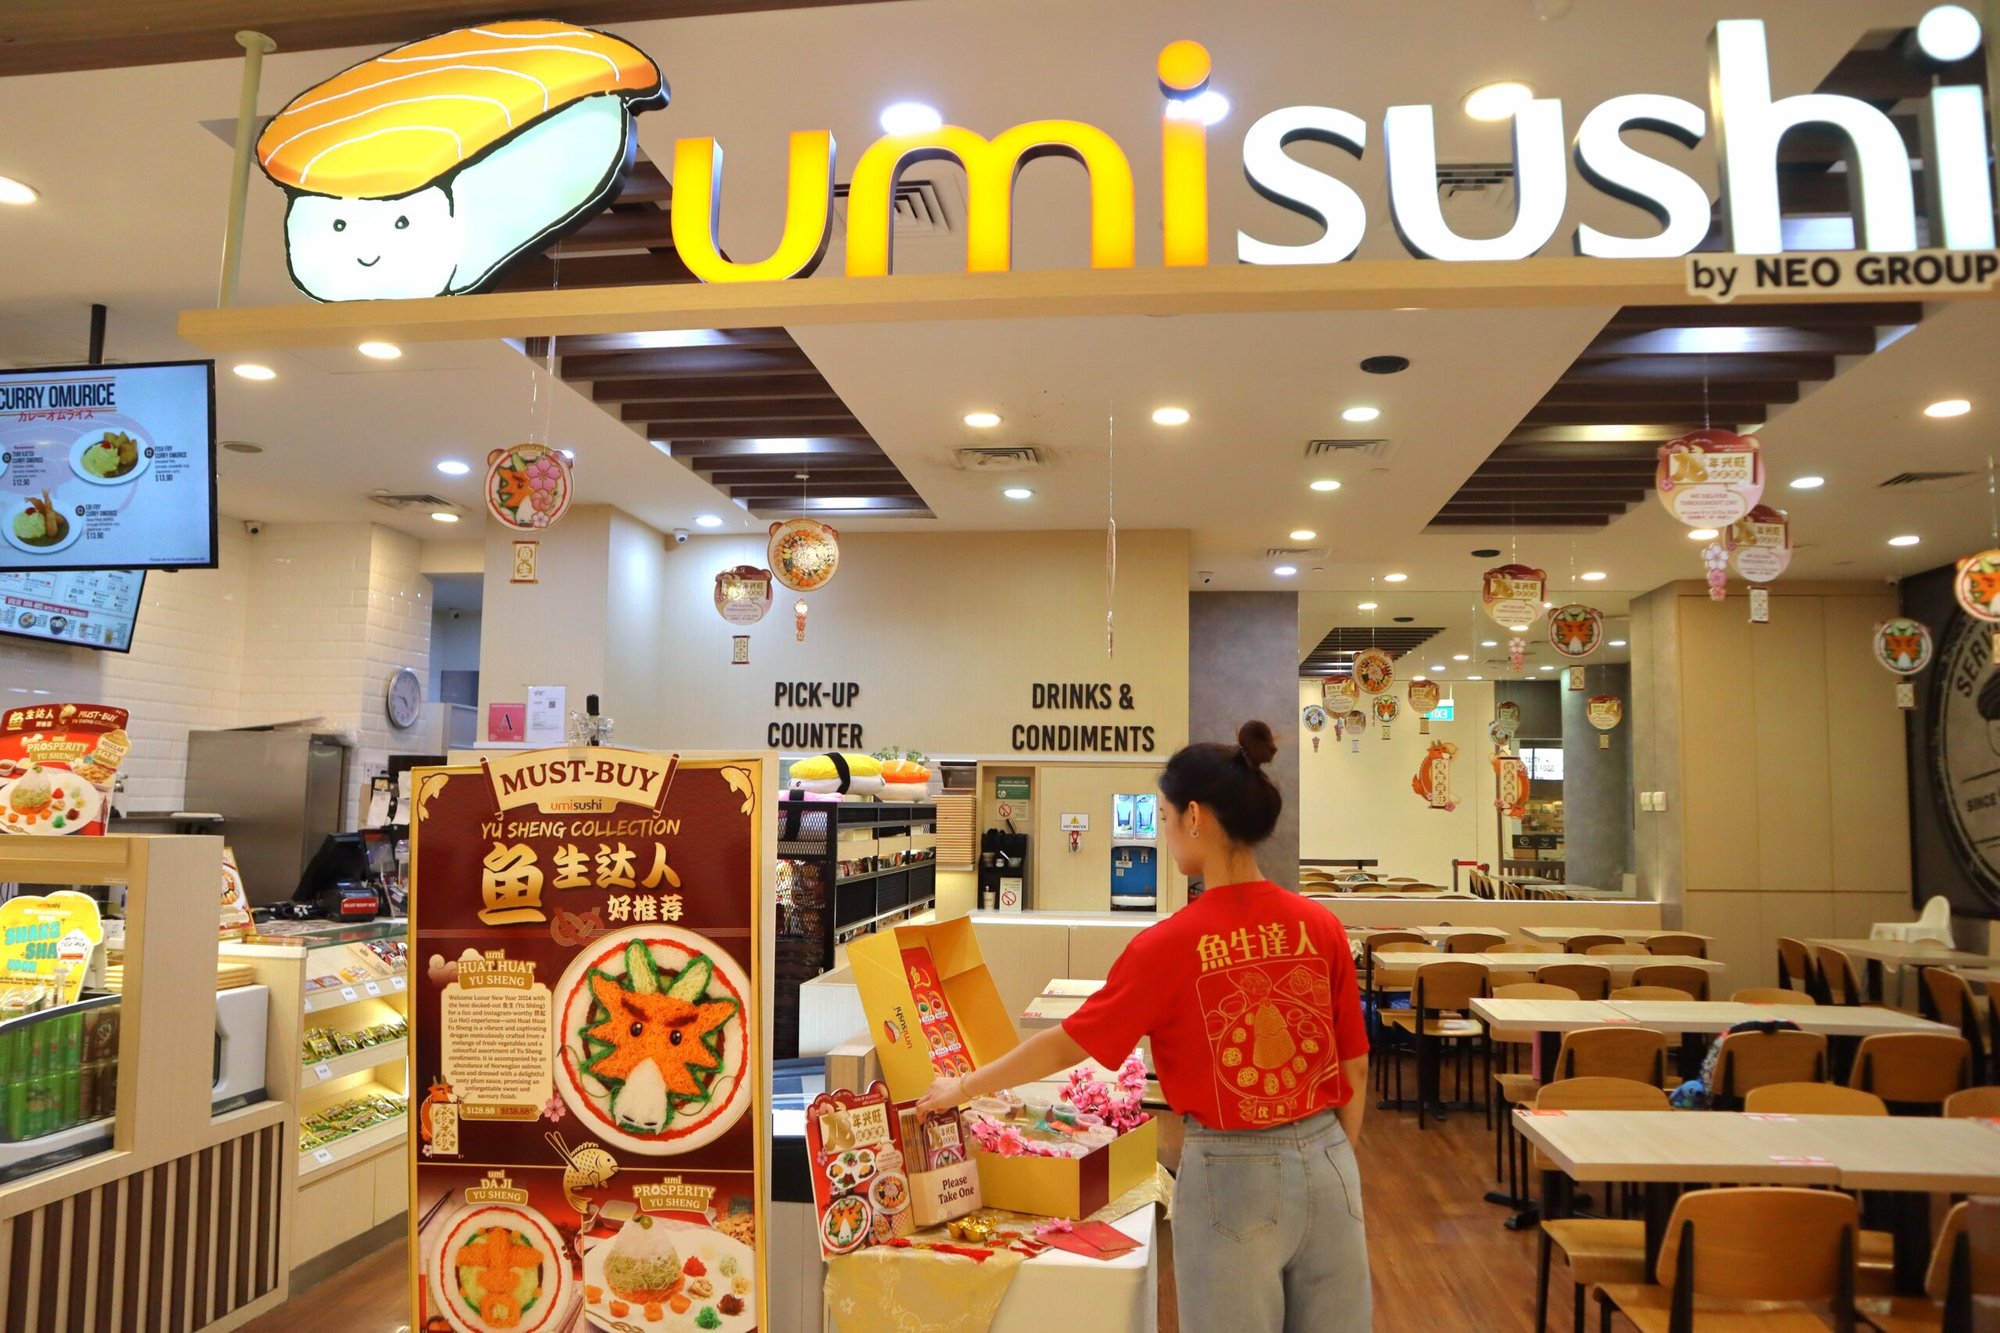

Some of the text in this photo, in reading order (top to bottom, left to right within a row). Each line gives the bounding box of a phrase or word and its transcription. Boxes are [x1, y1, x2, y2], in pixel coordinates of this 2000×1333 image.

[1694, 254, 1999, 296] by NEO GROUP
[0, 382, 116, 410] CURRY OMURICE
[18, 409, 94, 422] カレーオムライス
[774, 681, 860, 708] PICK-UP
[1031, 682, 1135, 710] DRINKS &
[77, 710, 118, 722] MUST-BUY
[767, 722, 863, 750] COUNTER
[1011, 724, 1156, 753] CONDIMENTS
[26, 741, 90, 753] PROSPERITY
[37, 752, 76, 761] YU SHENG
[499, 759, 660, 797] MUST-BUY
[551, 799, 602, 811] umisushi
[1965, 793, 1998, 812] SINCE
[480, 818, 682, 840] YU SHENG COLLECTION
[477, 841, 682, 927] 鱼生达人
[607, 894, 684, 923] 好推荐
[5, 921, 60, 945] SHAKE
[25, 942, 58, 960] SHA
[1196, 920, 1319, 973] 魚生達人
[458, 961, 536, 974] HUAT HUAT
[469, 975, 525, 987] YU SHENG
[894, 1006, 912, 1049] umisushi
[466, 1106, 495, 1115] $128.88
[487, 1169, 505, 1179] umi
[663, 1176, 682, 1186] umi
[942, 1175, 968, 1190] Please
[481, 1178, 513, 1190] DA JI
[632, 1184, 716, 1199] PROSPERITY
[473, 1190, 521, 1202] YU SHENG
[650, 1198, 700, 1209] YU SHENG
[938, 1185, 975, 1205] Take One
